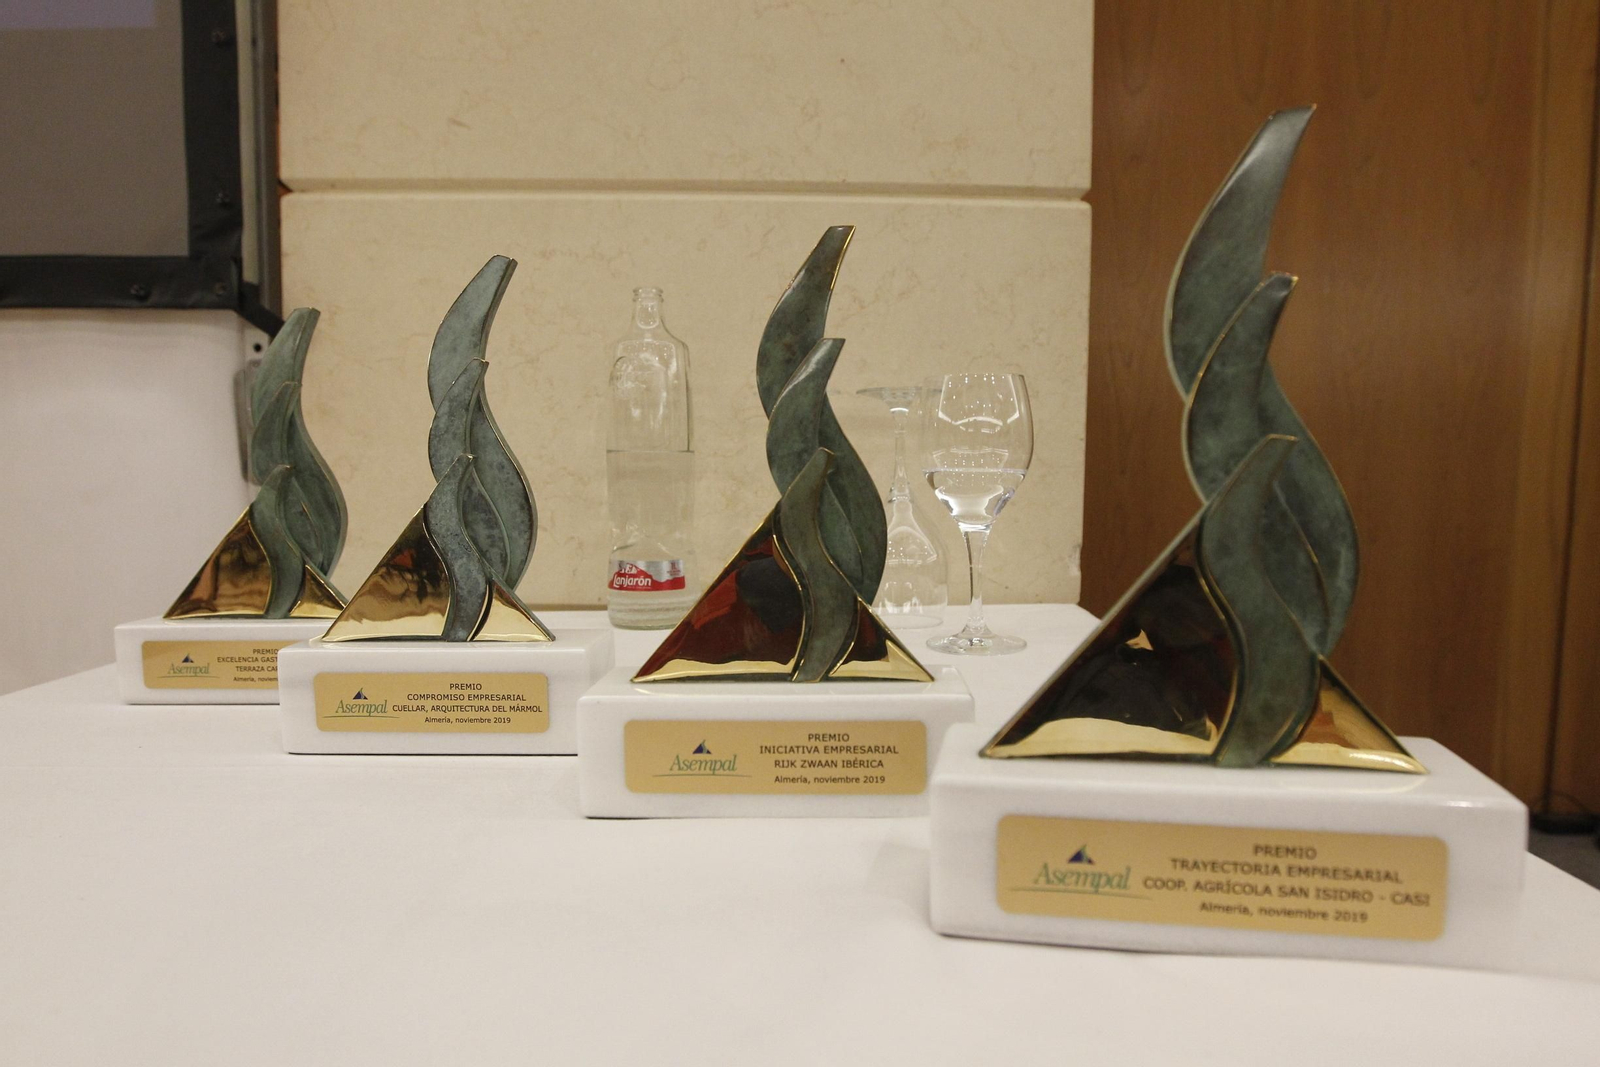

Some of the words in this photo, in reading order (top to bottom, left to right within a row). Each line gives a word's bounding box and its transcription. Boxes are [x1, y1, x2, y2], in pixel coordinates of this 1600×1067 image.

[613, 574, 652, 588] Lanjarón
[167, 662, 210, 676] Asempal
[449, 683, 482, 691] PREMIO
[407, 693, 465, 701] COMPROMISO
[467, 693, 526, 702] EMPRESARIAL
[335, 699, 388, 717] Asempal
[392, 704, 429, 713] CUELLAR,
[430, 704, 490, 713] ARQUITECTURA
[492, 705, 508, 713] DEL
[509, 703, 542, 713] MÁRMOL
[424, 716, 453, 725] Almería,
[455, 716, 492, 724] noviembre
[808, 733, 850, 742] PREMIO
[760, 745, 820, 755] INICIATIVA
[823, 745, 899, 754] EMPRESARIAL
[669, 754, 737, 775] Asempal
[774, 760, 797, 769] RIJK
[800, 760, 838, 769] ZWAAN
[841, 758, 884, 769] IBÉRICA
[774, 775, 810, 785] Almería,
[814, 775, 860, 784] noviembre
[863, 776, 885, 784] 2019
[1253, 843, 1317, 860] PREMIO
[1033, 861, 1132, 893] Asempal
[1170, 858, 1281, 878] TRAYECTORIA
[1287, 864, 1403, 884] EMPRESARIAL
[1143, 876, 1188, 892] COOP.
[1194, 876, 1273, 897] AGRÍCOLA
[1277, 883, 1310, 899] SAN
[1315, 886, 1374, 904] ISIDRO
[1390, 891, 1431, 907] CASI
[1199, 900, 1253, 918] Almería,
[1258, 904, 1330, 921] noviembre
[1333, 909, 1368, 924] 2019
